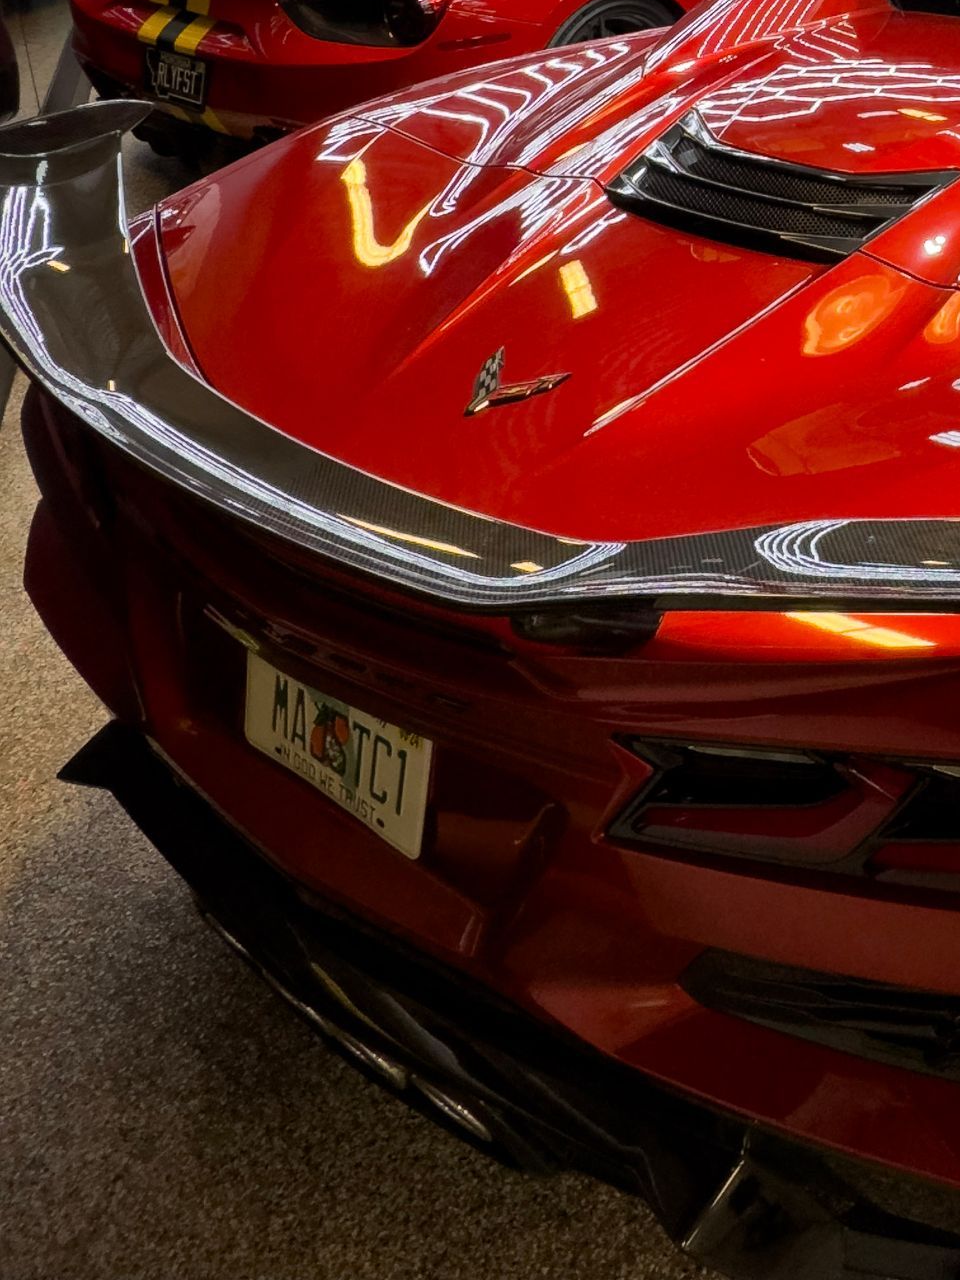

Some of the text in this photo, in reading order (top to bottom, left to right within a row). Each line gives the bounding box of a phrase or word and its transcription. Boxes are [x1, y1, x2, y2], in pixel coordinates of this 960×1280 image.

[293, 751, 316, 779] GOD
[319, 769, 335, 793] WE
[338, 782, 377, 824] TRUST
